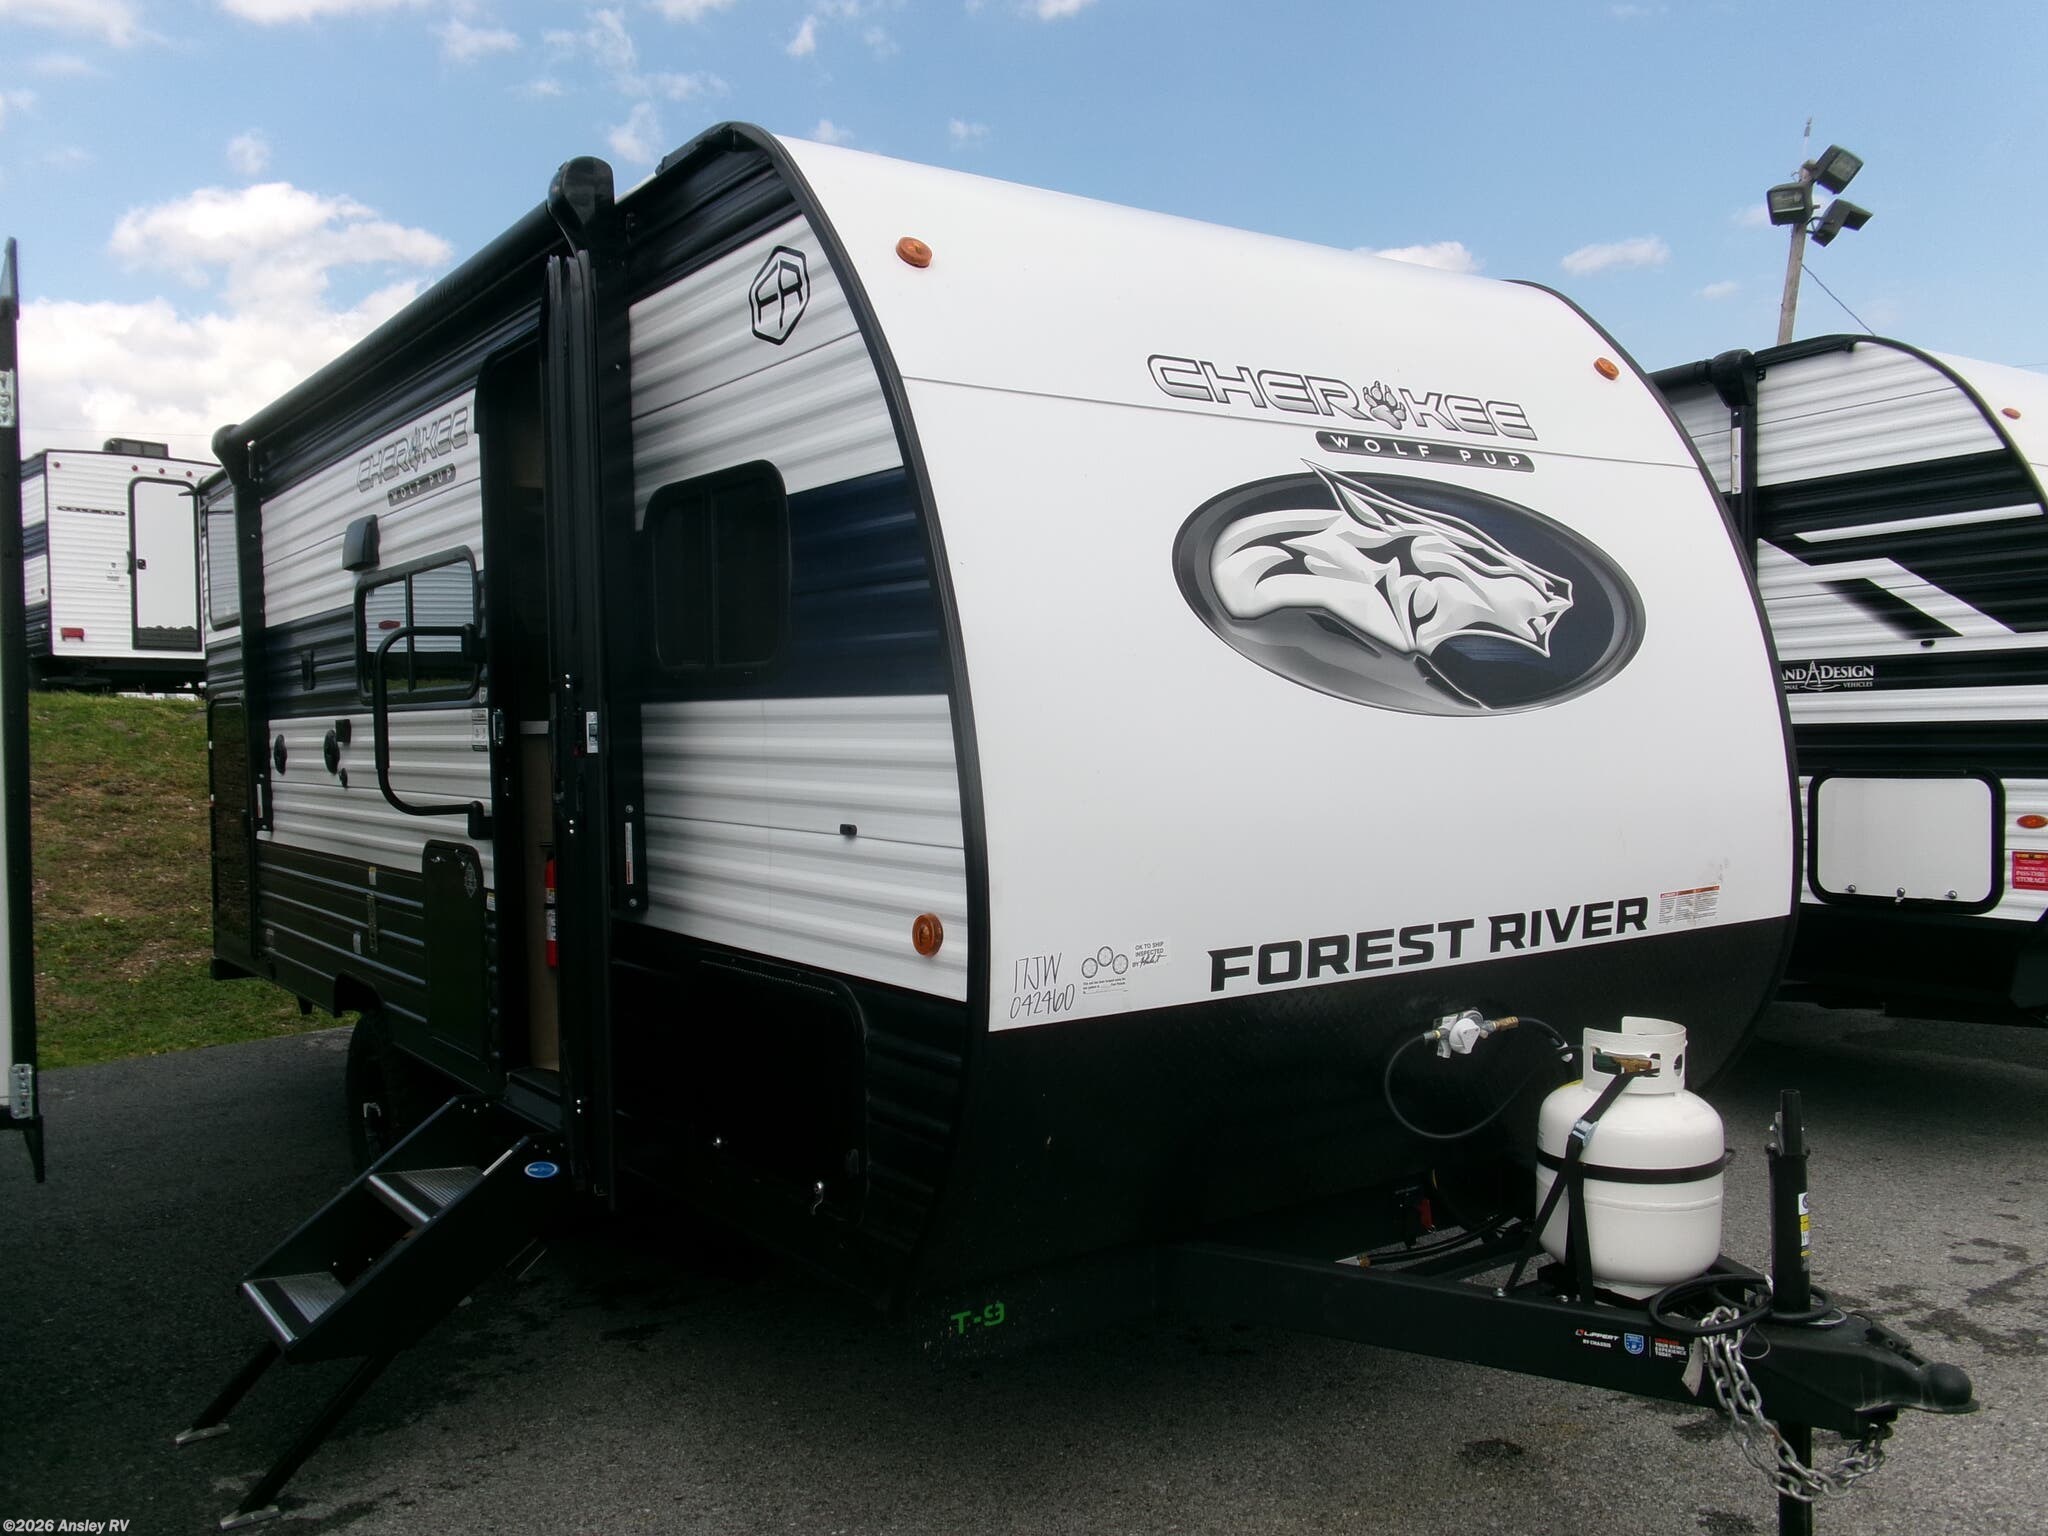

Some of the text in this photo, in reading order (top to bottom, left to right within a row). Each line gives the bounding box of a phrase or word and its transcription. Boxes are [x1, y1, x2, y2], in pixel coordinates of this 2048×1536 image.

[1330, 435, 1521, 467] WOLF PUP
[391, 468, 453, 499] WOLF PUP
[1820, 665, 1874, 679] DESIGN
[1207, 918, 1475, 992] FOREST
[1488, 896, 1649, 954] RIVER
